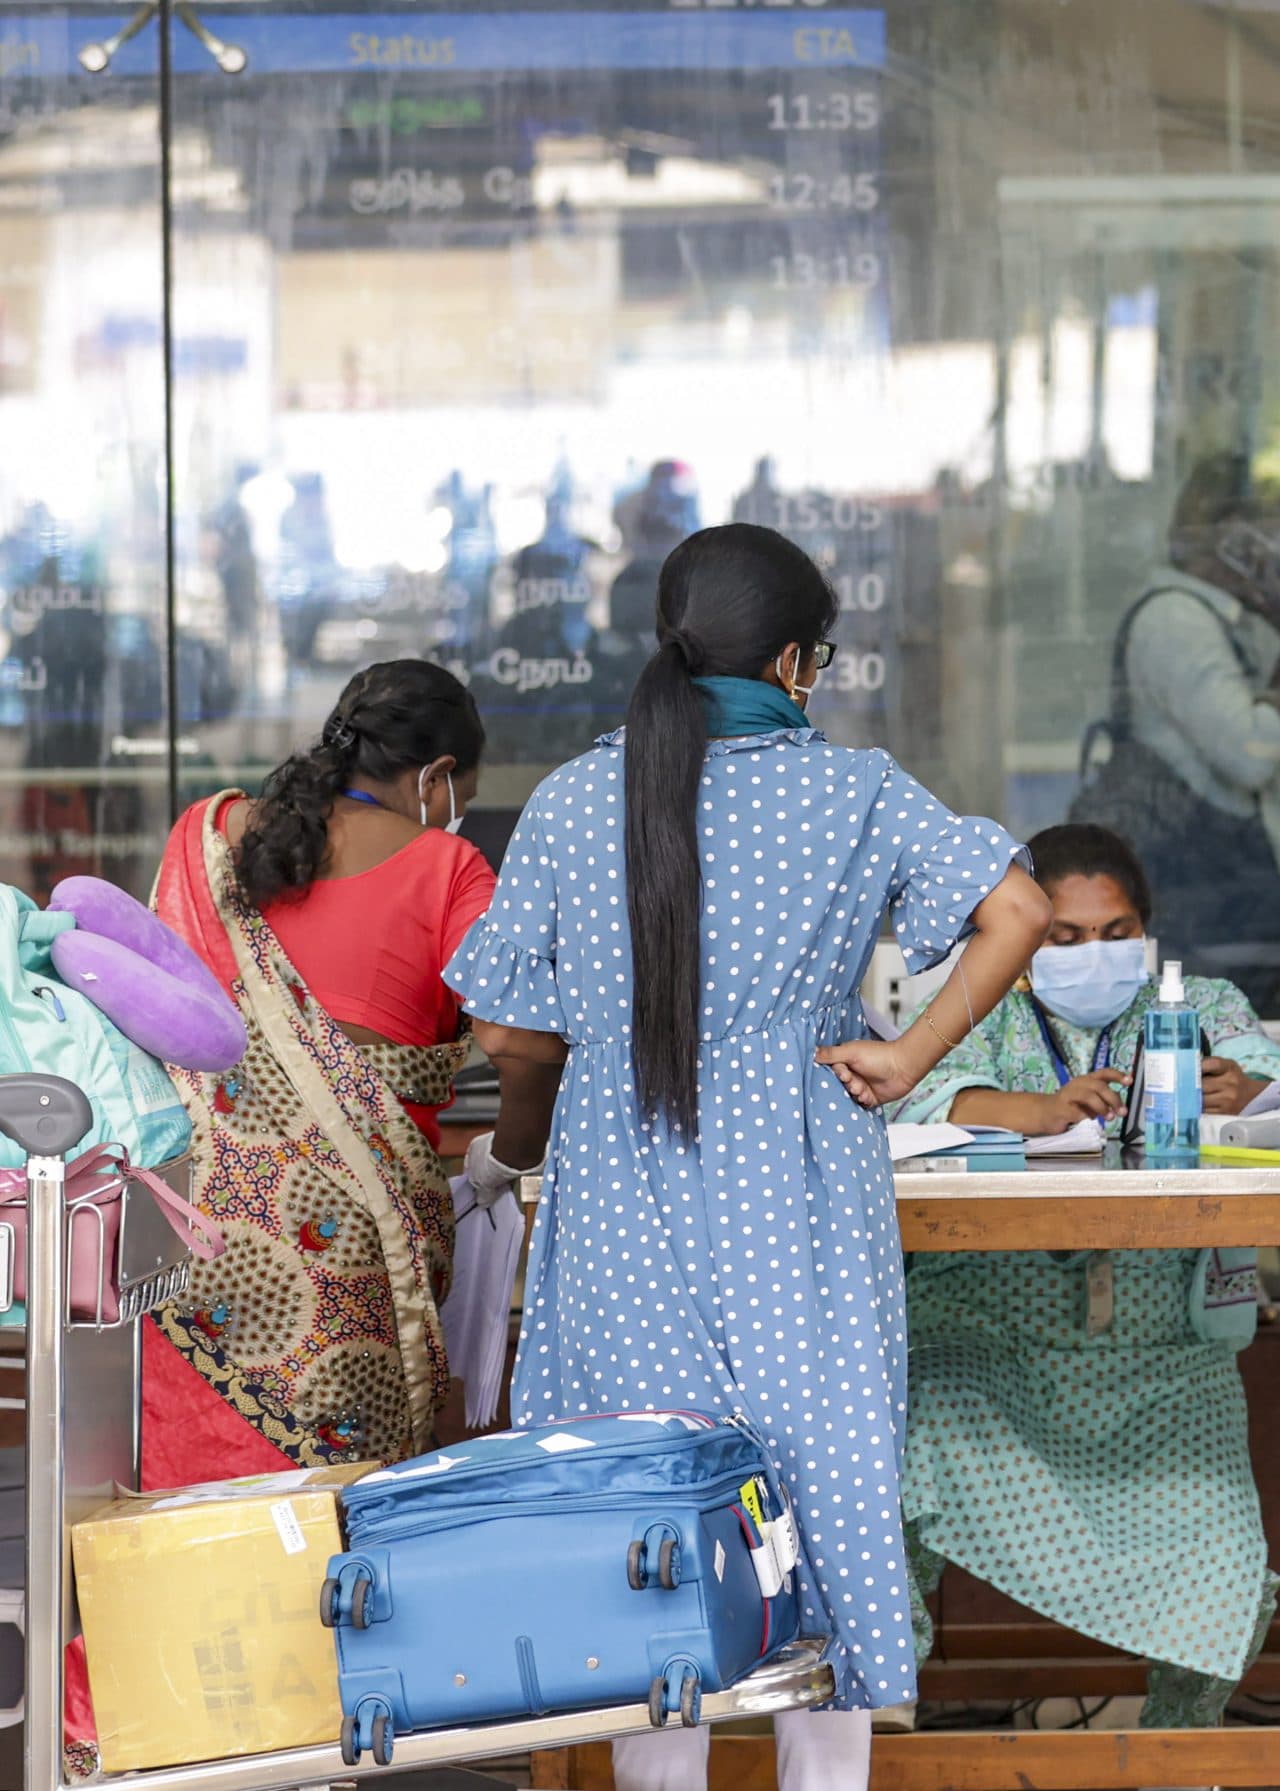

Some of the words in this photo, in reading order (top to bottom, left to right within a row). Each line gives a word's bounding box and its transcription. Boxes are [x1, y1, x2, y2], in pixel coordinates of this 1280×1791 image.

[347, 31, 456, 64] Status
[793, 27, 858, 61] ETA
[767, 93, 880, 130] 11:35
[767, 172, 880, 210] 12:45
[489, 647, 594, 694] நேரம்
[813, 652, 886, 692] :30
